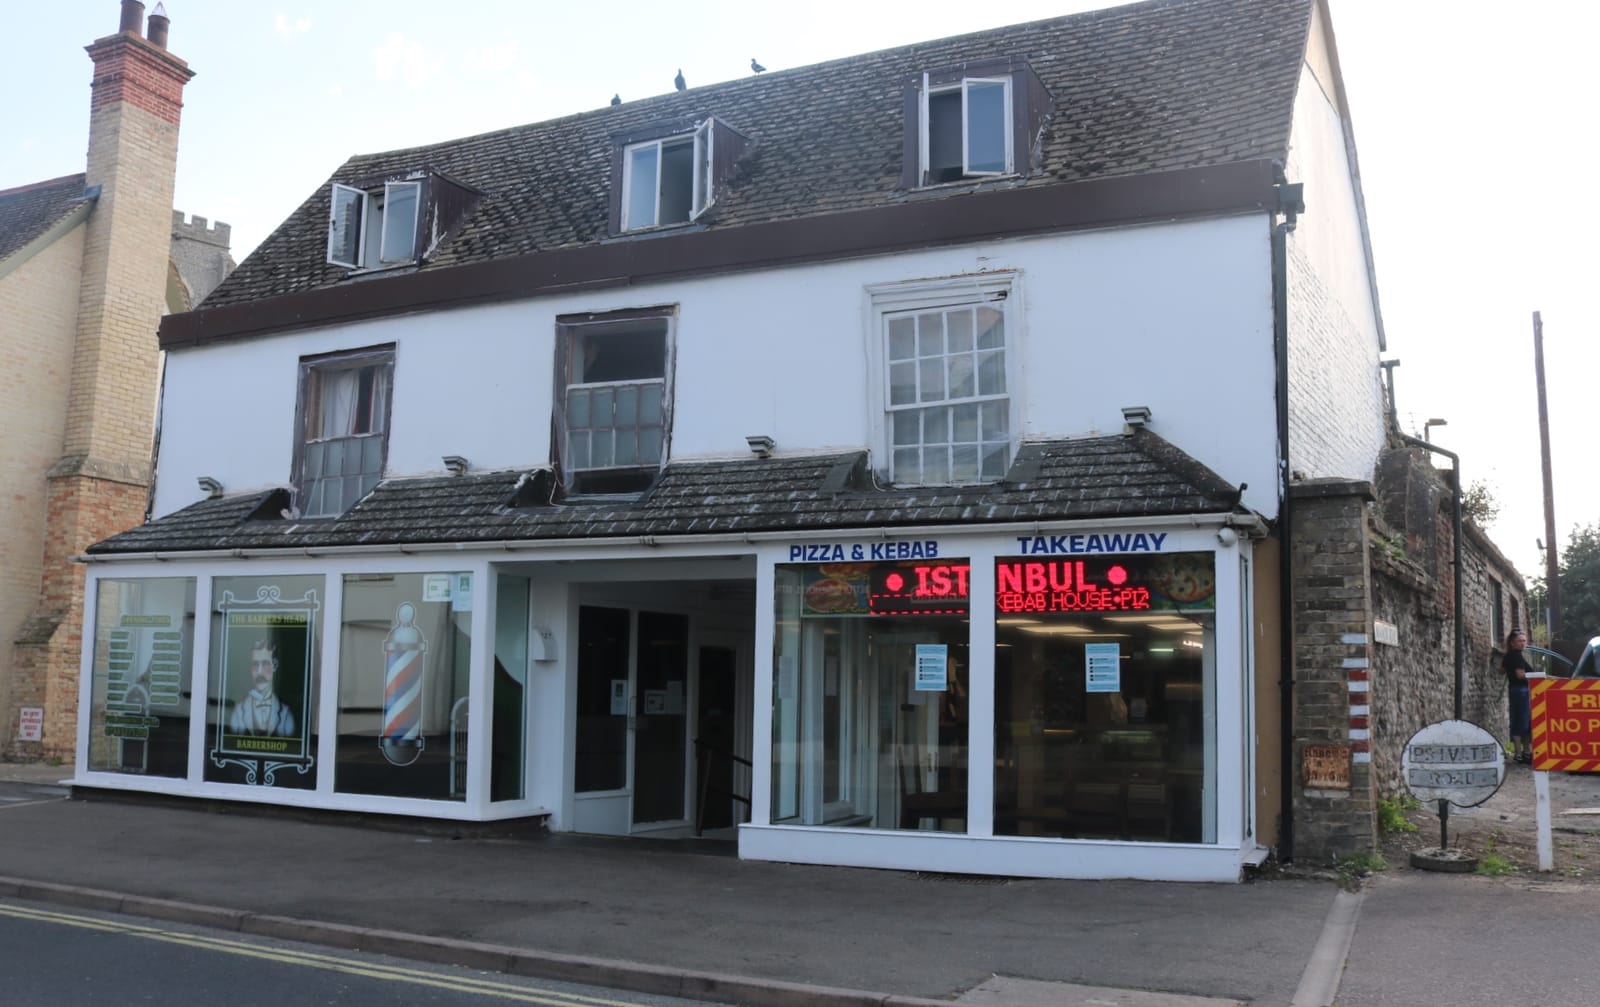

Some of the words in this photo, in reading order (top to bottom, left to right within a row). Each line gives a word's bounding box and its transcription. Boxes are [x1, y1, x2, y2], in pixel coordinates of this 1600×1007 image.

[789, 544, 845, 562] PIZZA
[851, 544, 865, 560] &
[871, 541, 938, 560] KEBAB
[1017, 532, 1168, 554] TAKEAWAY
[1051, 589, 1113, 608] HOUSE
[1550, 718, 1582, 733] NO
[236, 738, 288, 752] BARBERSHOP
[1551, 741, 1582, 756] NO
